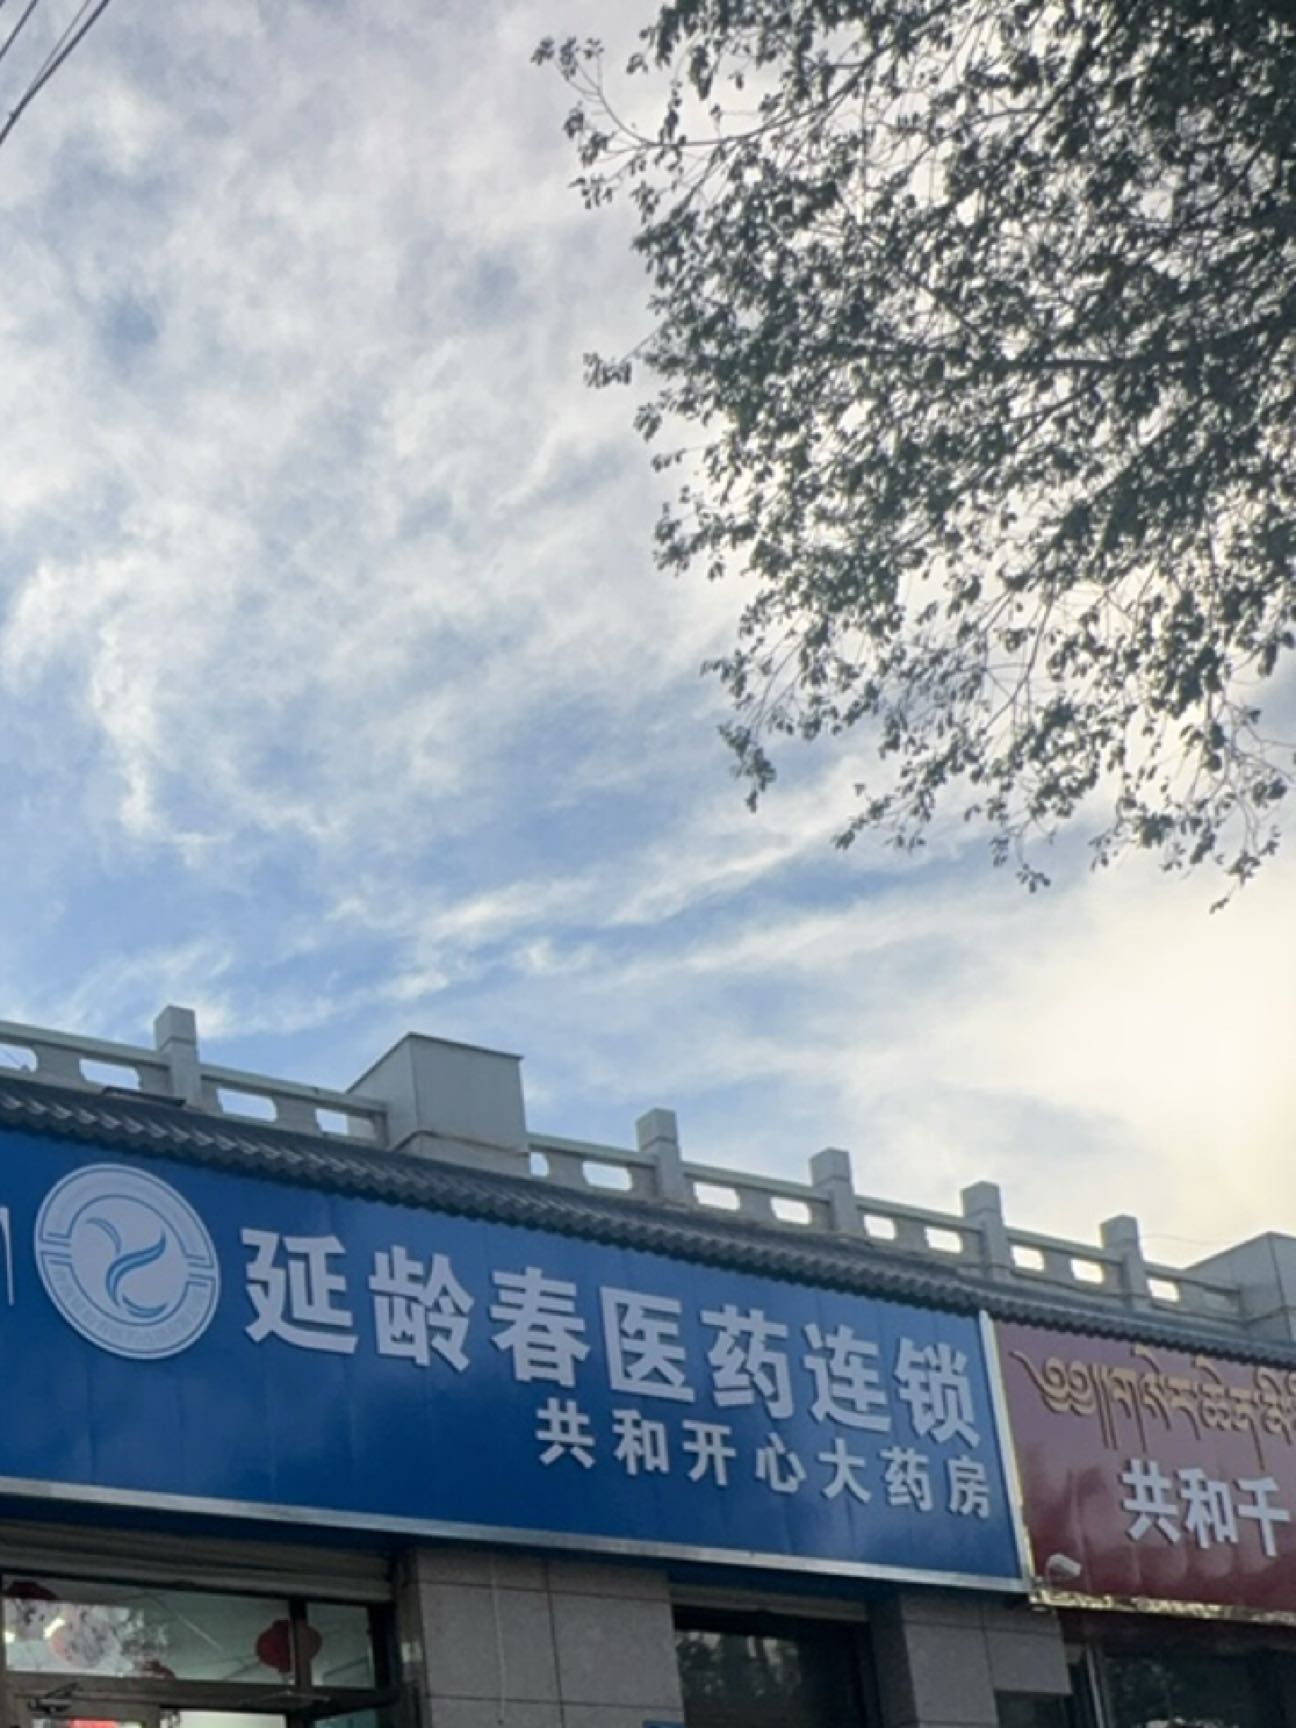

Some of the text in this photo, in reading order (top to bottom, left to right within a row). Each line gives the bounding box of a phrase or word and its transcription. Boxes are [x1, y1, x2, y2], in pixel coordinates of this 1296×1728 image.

[241, 1228, 981, 1447] 延龄春医药连锁
[536, 1400, 991, 1519] 共和开心大药房
[1121, 1458, 1290, 1557] 共和千
